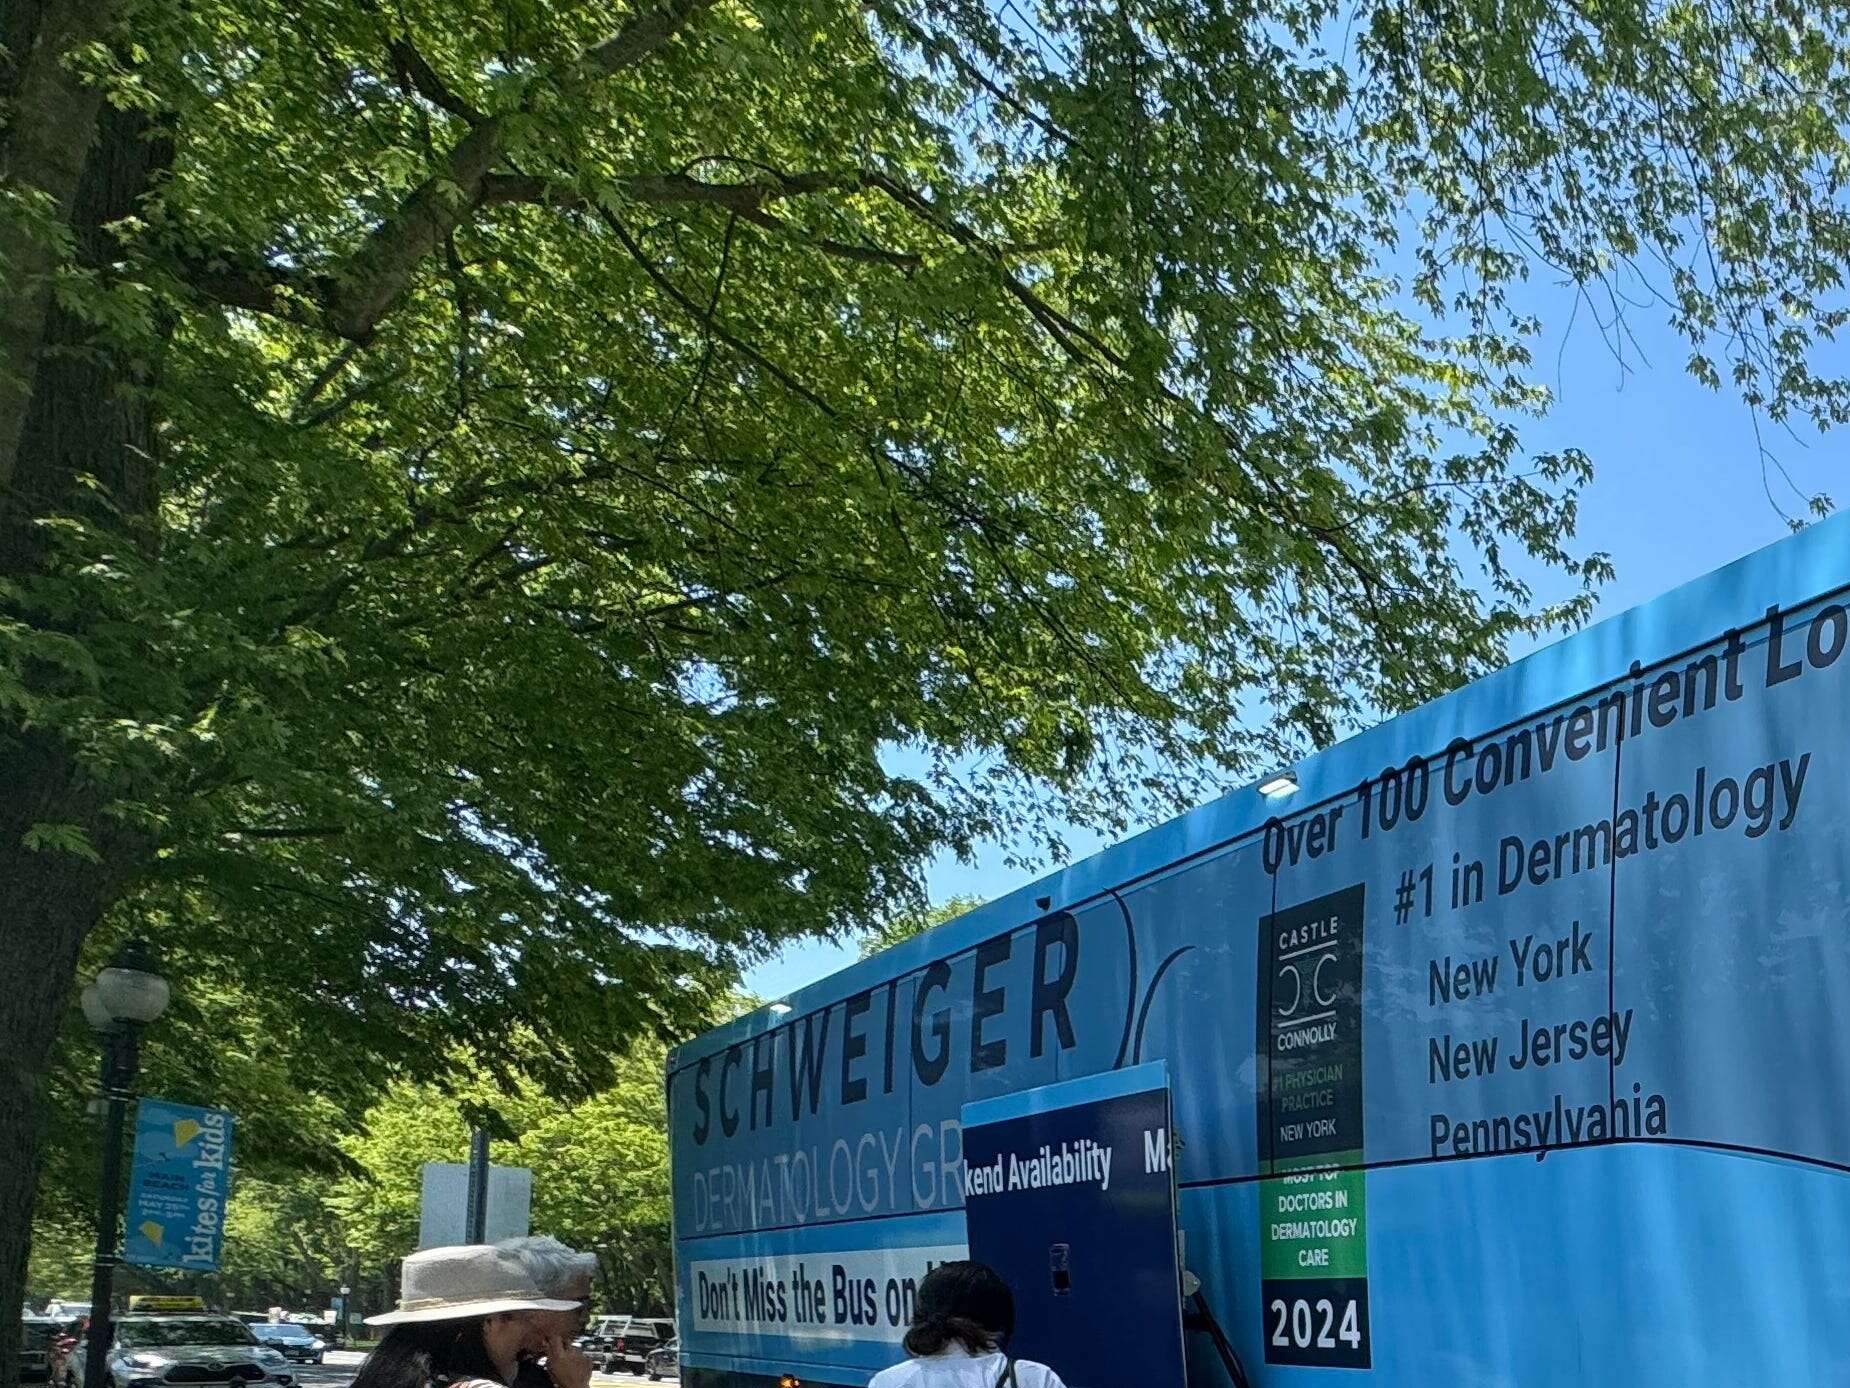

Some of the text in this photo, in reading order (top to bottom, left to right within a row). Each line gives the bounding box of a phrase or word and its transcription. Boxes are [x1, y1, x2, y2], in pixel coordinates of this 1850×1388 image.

[1262, 816, 1344, 875] Over
[1357, 755, 1430, 839] 100
[1443, 628, 1745, 806] Convenient
[1393, 752, 1811, 926] #1 in Dermatology
[1278, 915, 1339, 950] CASTLE
[1429, 921, 1593, 1007] New York
[693, 908, 1081, 1146] SCHWEIGER
[1277, 1022, 1337, 1051] CONNOLLY
[1429, 1009, 1633, 1084] New Jersey
[1281, 1089, 1335, 1113] PRACTICE
[1285, 1064, 1343, 1089] PHYSICIAN
[1279, 1119, 1337, 1143] NEW YORK
[1430, 1082, 1668, 1162] Pennsylvania
[182, 1113, 226, 1264] kites for kids
[694, 1127, 904, 1232] DERMATOLOGY
[963, 1154, 1003, 1196] kend
[1008, 1139, 1112, 1190] Availability
[1271, 1218, 1357, 1240] DERMATOLOGY
[1278, 1190, 1348, 1212] DOCTORS IN
[1298, 1248, 1329, 1267] CARE
[698, 1268, 740, 1322] Don't
[743, 1267, 787, 1324] Miss
[793, 1263, 826, 1325] the
[832, 1264, 876, 1326] Bus
[1271, 1298, 1361, 1349] 2024
